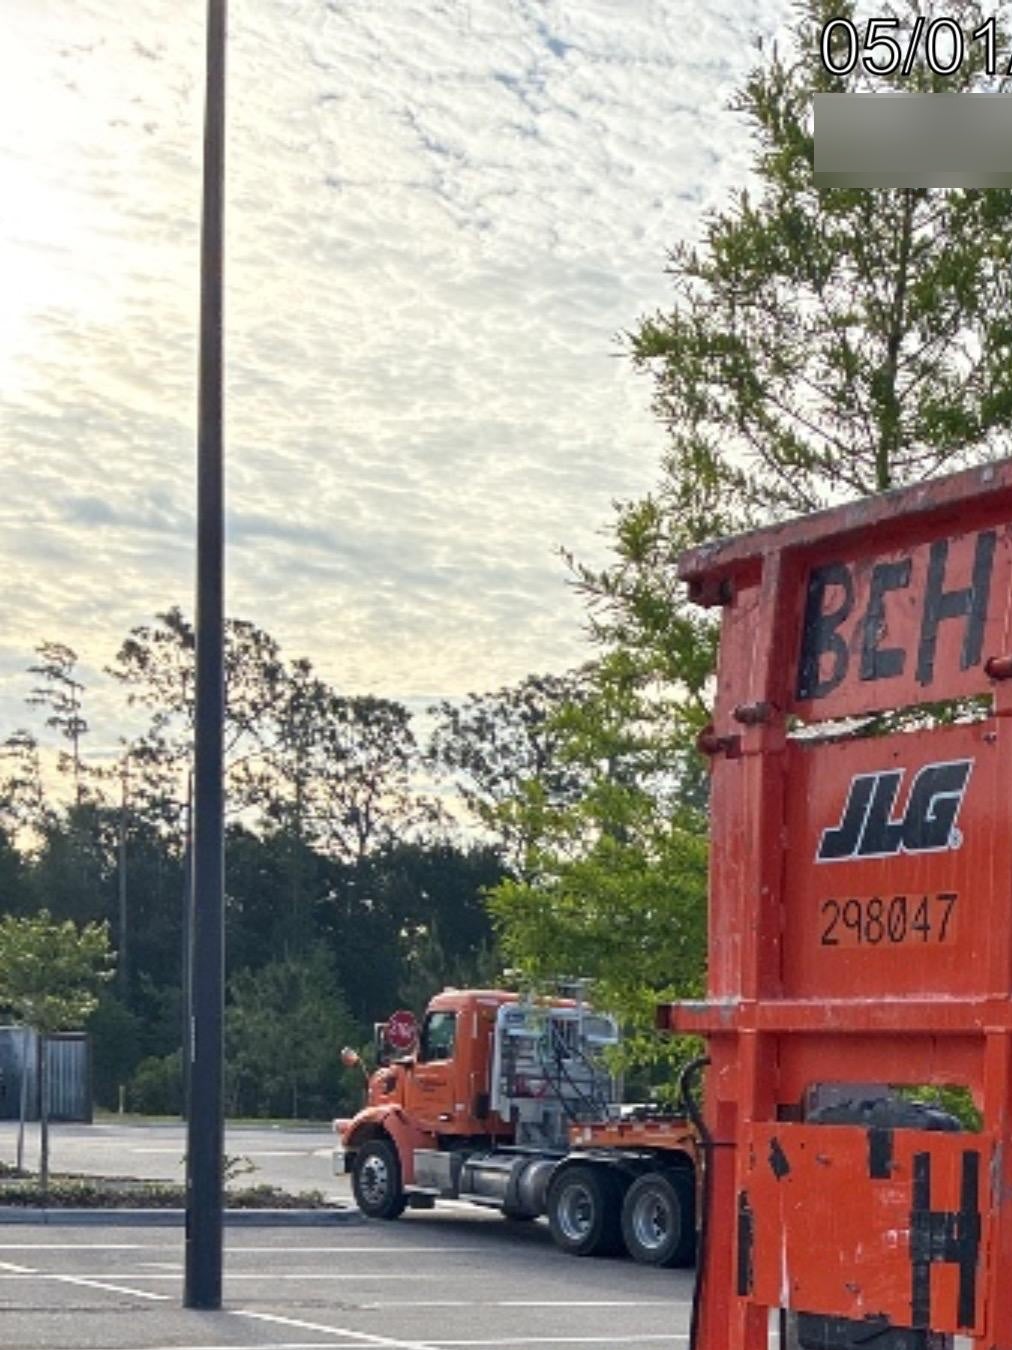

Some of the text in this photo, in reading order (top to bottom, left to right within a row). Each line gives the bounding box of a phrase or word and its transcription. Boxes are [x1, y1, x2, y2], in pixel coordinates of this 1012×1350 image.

[796, 531, 997, 701] BEH
[815, 757, 975, 864] JLG
[820, 893, 958, 946] 298047
